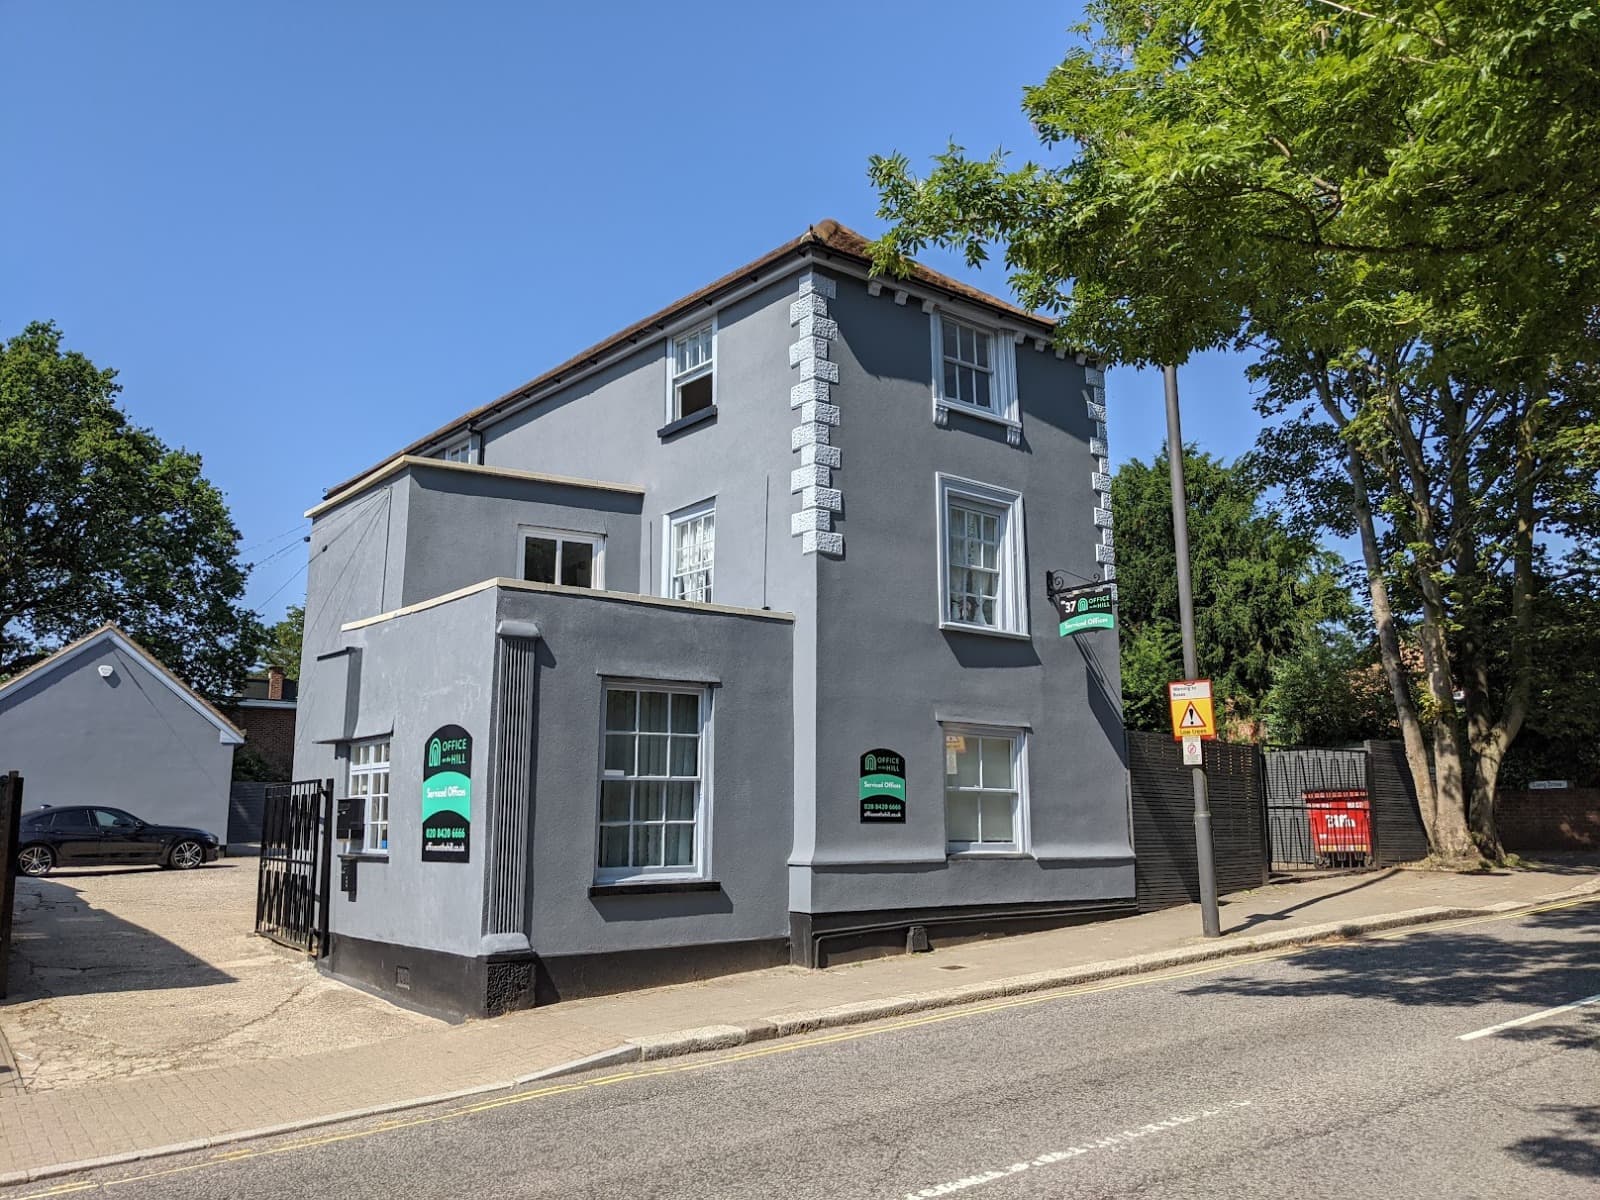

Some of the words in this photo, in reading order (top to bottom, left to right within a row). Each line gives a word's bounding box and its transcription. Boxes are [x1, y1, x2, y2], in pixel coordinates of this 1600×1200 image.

[1088, 594, 1110, 604] OFFICE
[1064, 600, 1076, 613] 37
[1097, 601, 1110, 609] HILL
[1087, 616, 1108, 626] Offices
[442, 738, 467, 752] OFFICE
[451, 753, 466, 765] HILL
[877, 756, 900, 764] OFFICE
[448, 786, 466, 797] Offices
[426, 828, 436, 838] 020
[437, 828, 451, 838] 8420
[452, 828, 465, 838] 6666
